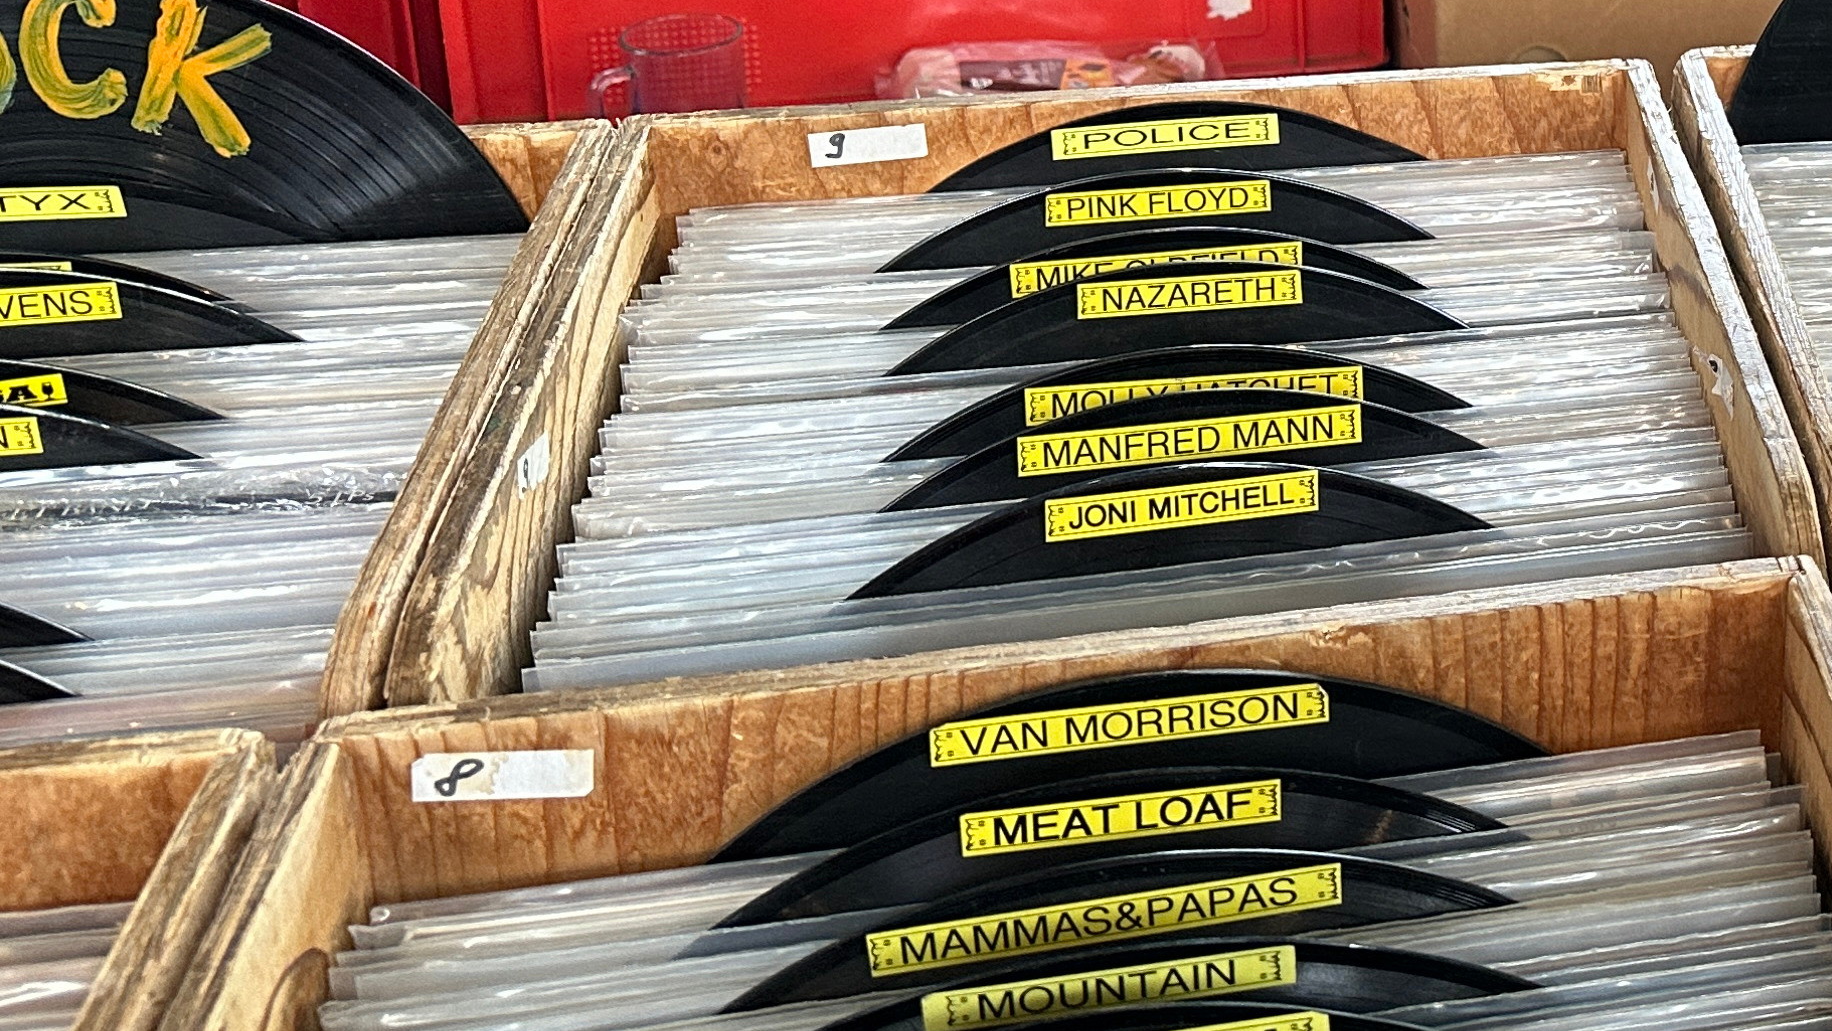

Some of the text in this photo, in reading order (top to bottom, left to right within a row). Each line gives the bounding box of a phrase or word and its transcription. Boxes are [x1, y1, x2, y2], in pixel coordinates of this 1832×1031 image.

[828, 132, 846, 159] 9
[1082, 120, 1251, 151] POLICE
[0, 193, 91, 213] TYX
[1066, 185, 1250, 220] PINK FLOYD
[1101, 277, 1277, 312] NAZARETH
[1041, 414, 1335, 469] MANFRED MANN
[1067, 482, 1295, 531] JONI MITCHELL
[959, 693, 1300, 755] VAN MORRISON
[433, 757, 485, 797] 8
[992, 788, 1254, 846] MEAT LOAF
[899, 876, 1299, 966] MAMMAS&PAPAS
[977, 958, 1237, 1024] MOUNTAIN
